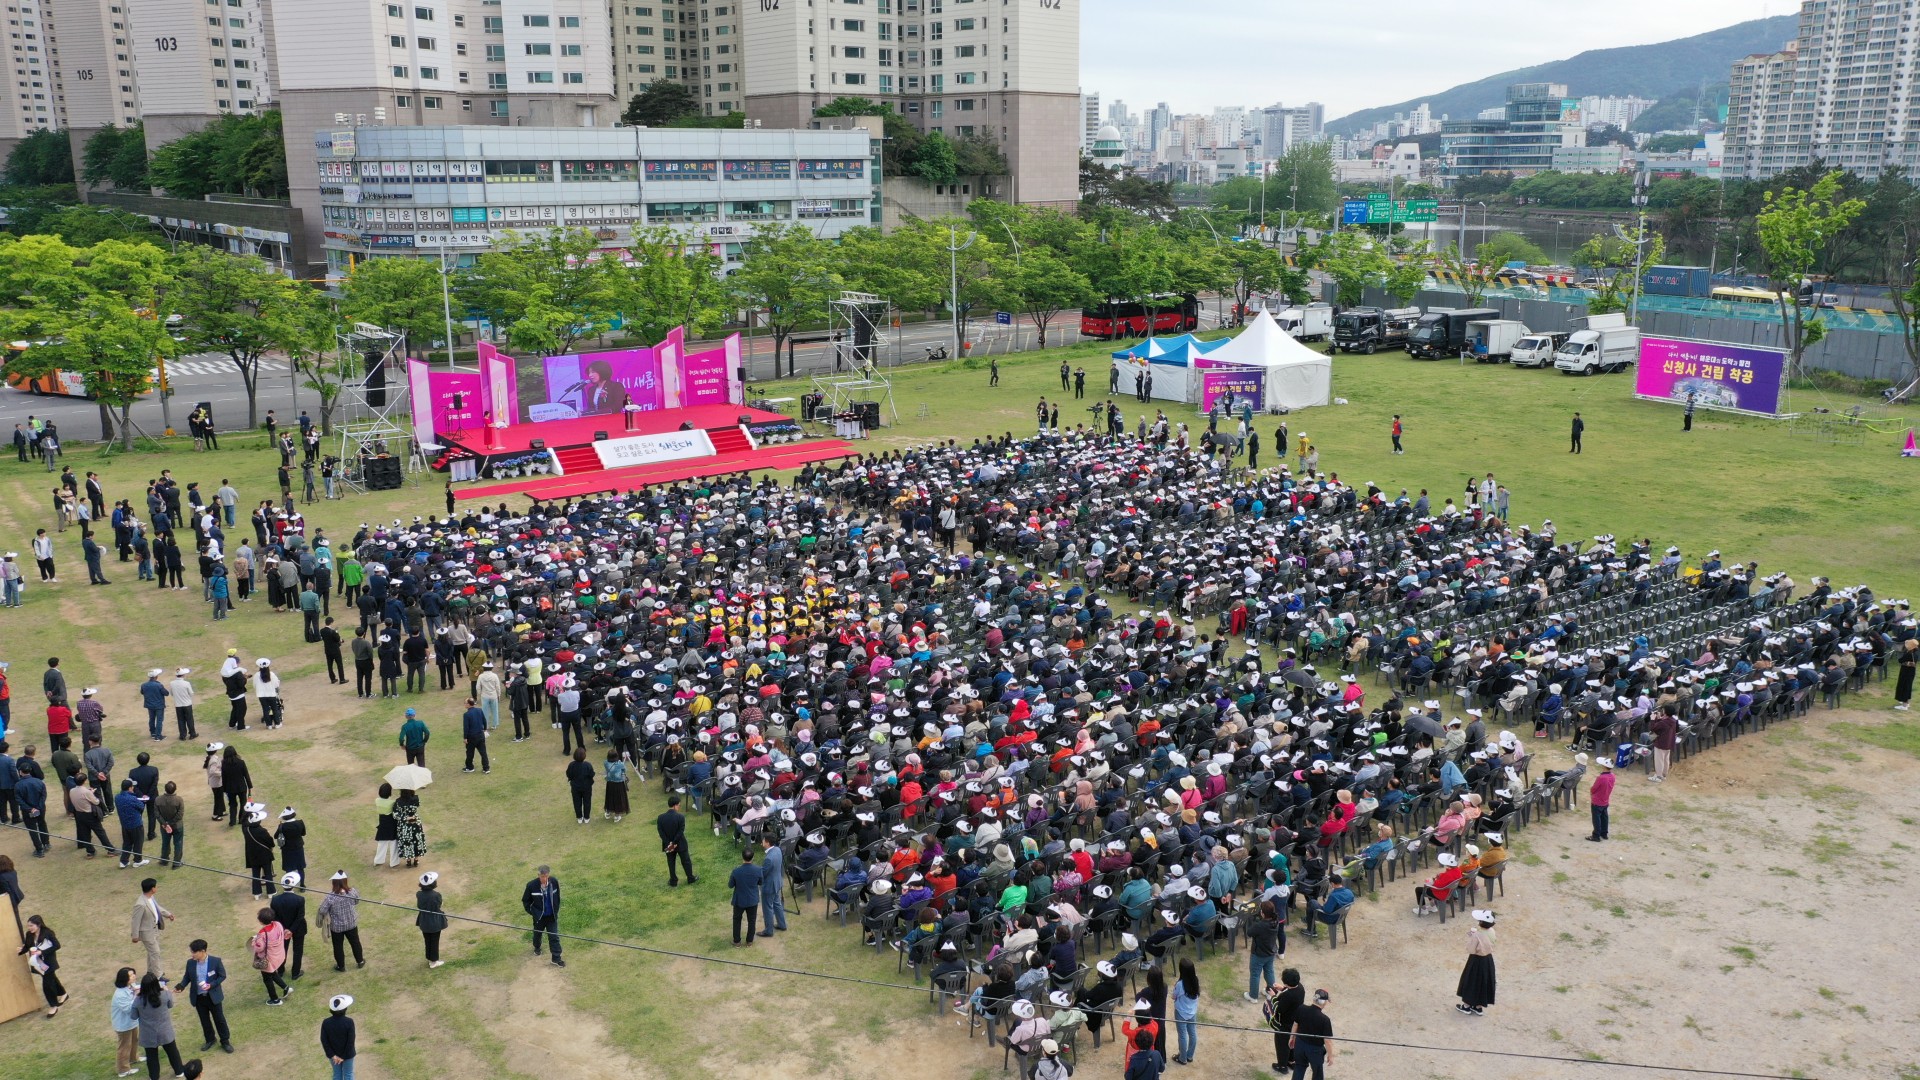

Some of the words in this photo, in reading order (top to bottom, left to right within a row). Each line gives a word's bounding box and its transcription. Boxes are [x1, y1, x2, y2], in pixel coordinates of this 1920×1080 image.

[155, 37, 178, 51] 103
[77, 70, 94, 80] 105
[1663, 360, 1697, 376] 신청사
[1701, 364, 1724, 380] 건립
[1729, 368, 1754, 384] 착공
